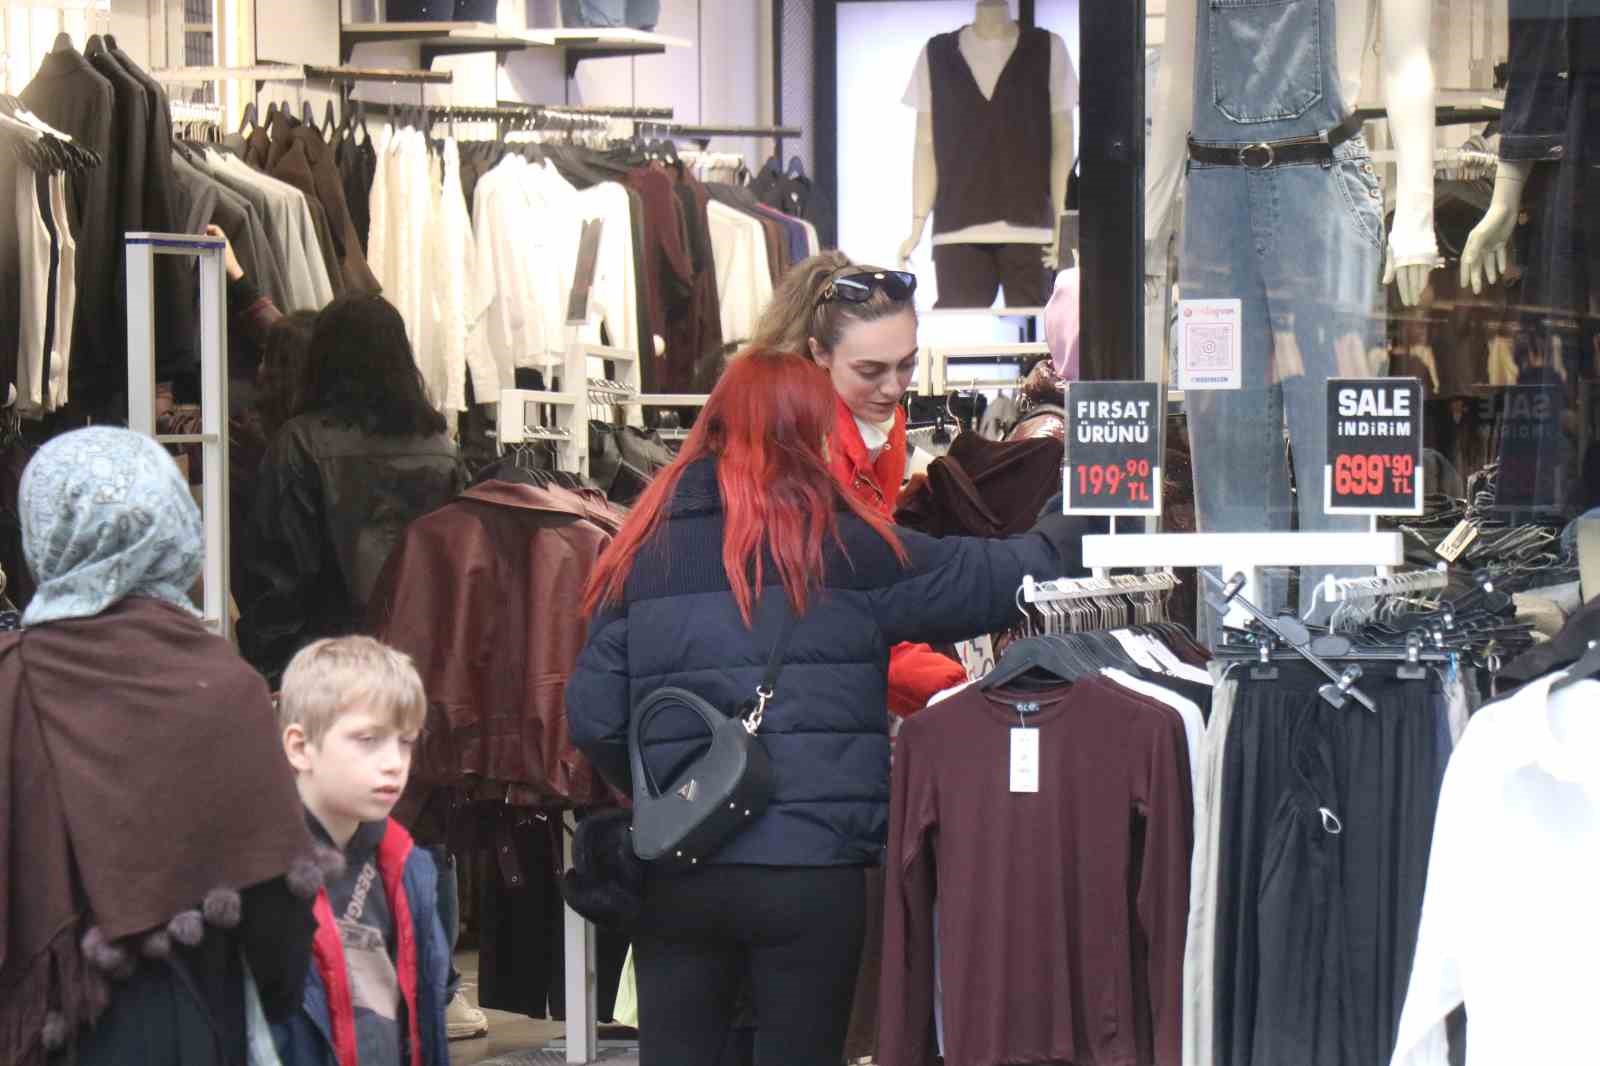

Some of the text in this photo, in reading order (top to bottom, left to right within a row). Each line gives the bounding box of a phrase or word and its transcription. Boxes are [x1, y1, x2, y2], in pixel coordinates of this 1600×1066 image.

[1077, 400, 1150, 419] FIRSAT
[1337, 388, 1411, 416] SALE
[1077, 420, 1149, 443] ÜRÜNÜ
[1127, 482, 1149, 502] TL
[1392, 478, 1413, 494] TL
